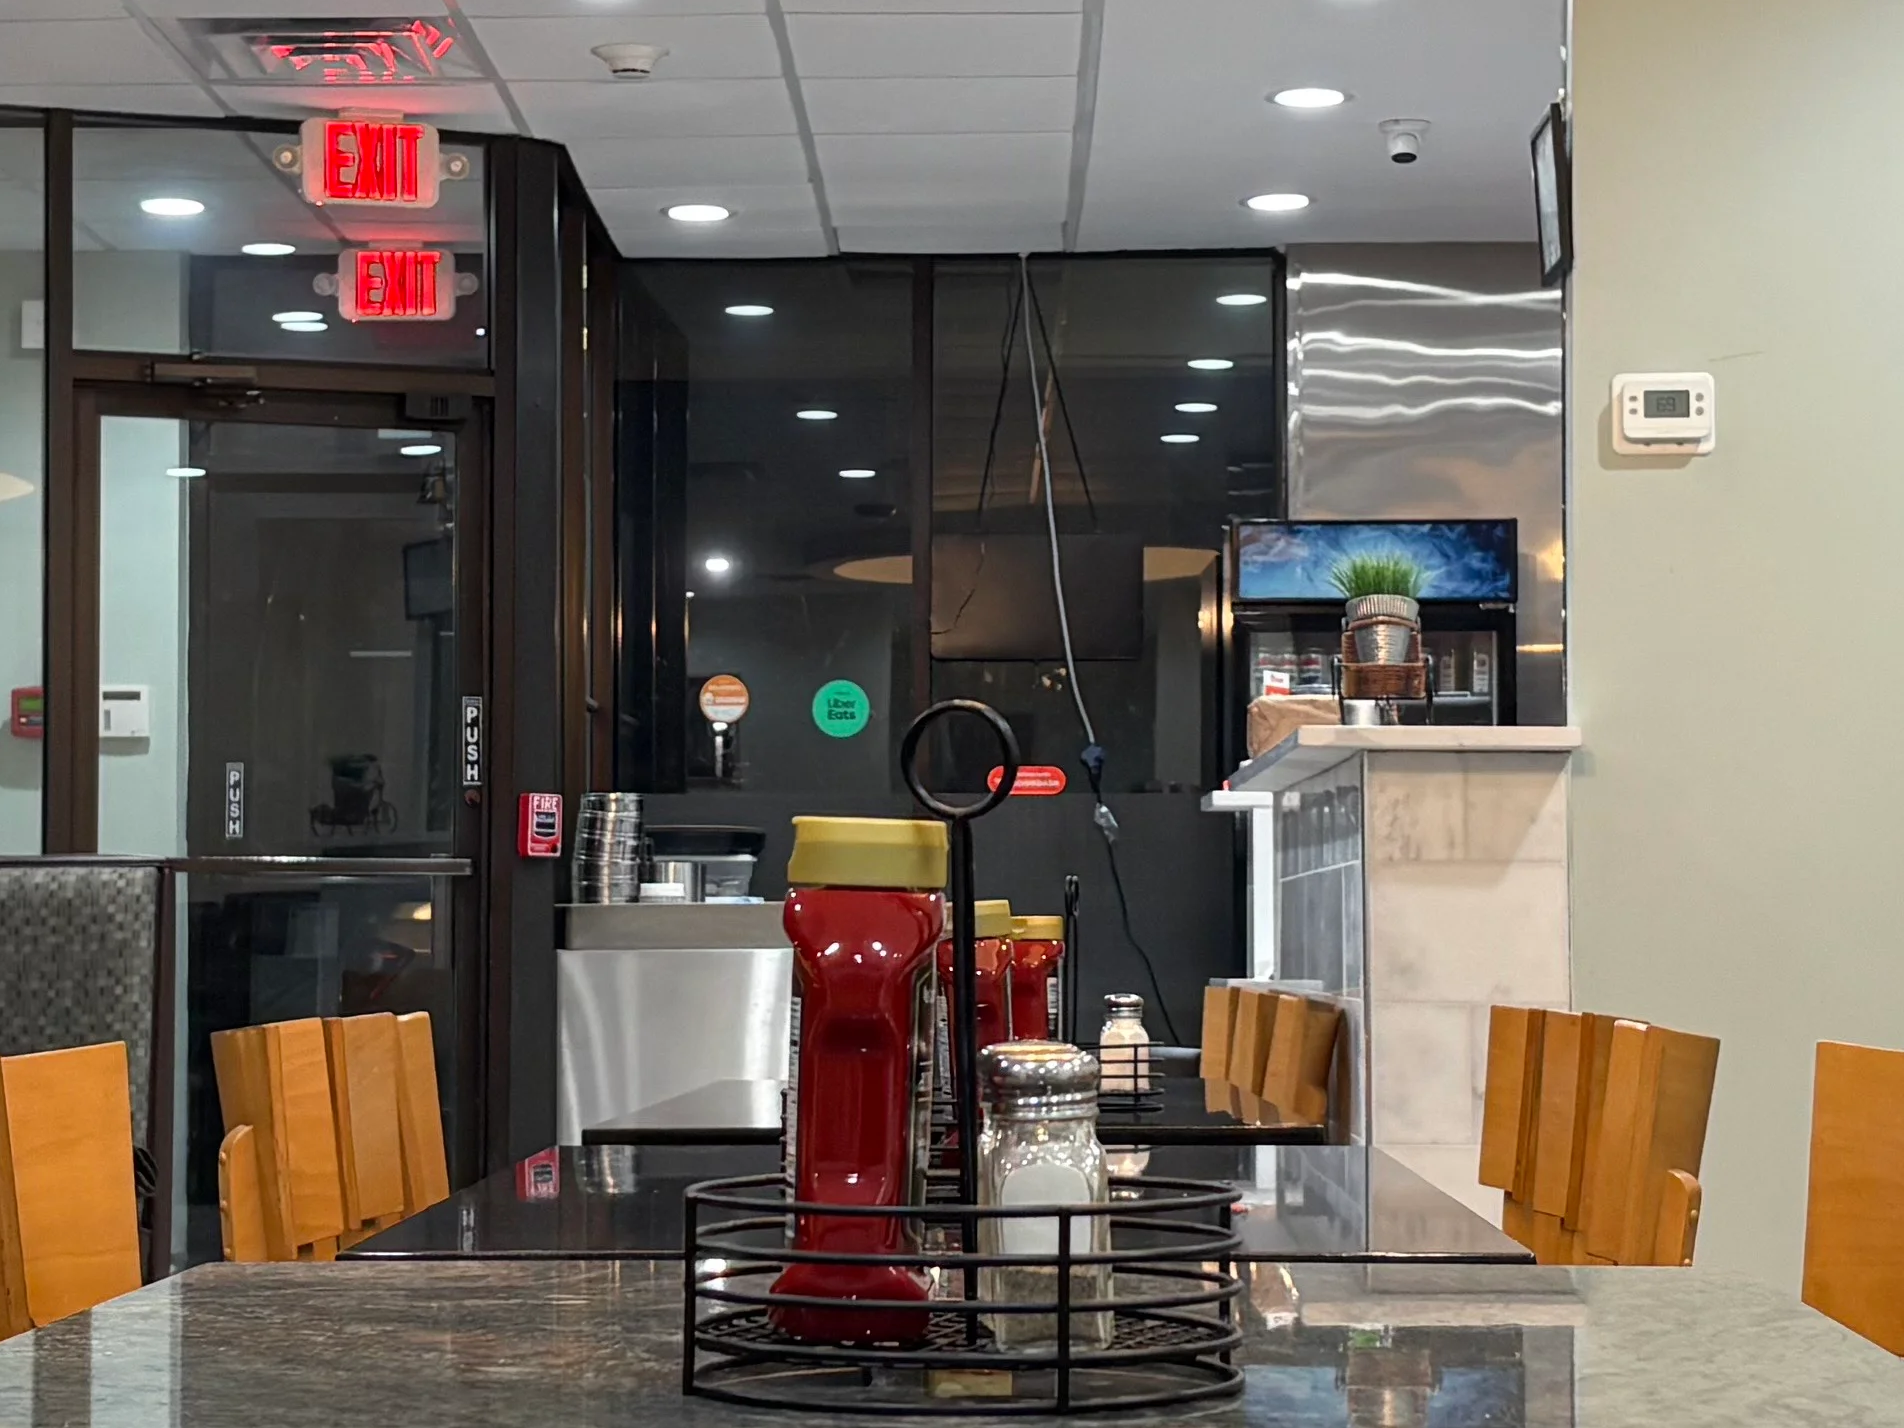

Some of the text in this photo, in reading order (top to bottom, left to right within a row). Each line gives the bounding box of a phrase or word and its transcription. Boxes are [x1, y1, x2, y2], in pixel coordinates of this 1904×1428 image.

[325, 121, 424, 201] EXIT
[357, 251, 441, 316] EXIT
[827, 698, 856, 710] Uber
[827, 709, 856, 721] Eats
[466, 706, 479, 781] PUSH
[229, 770, 241, 835] PUSH
[533, 795, 559, 810] FIRE
